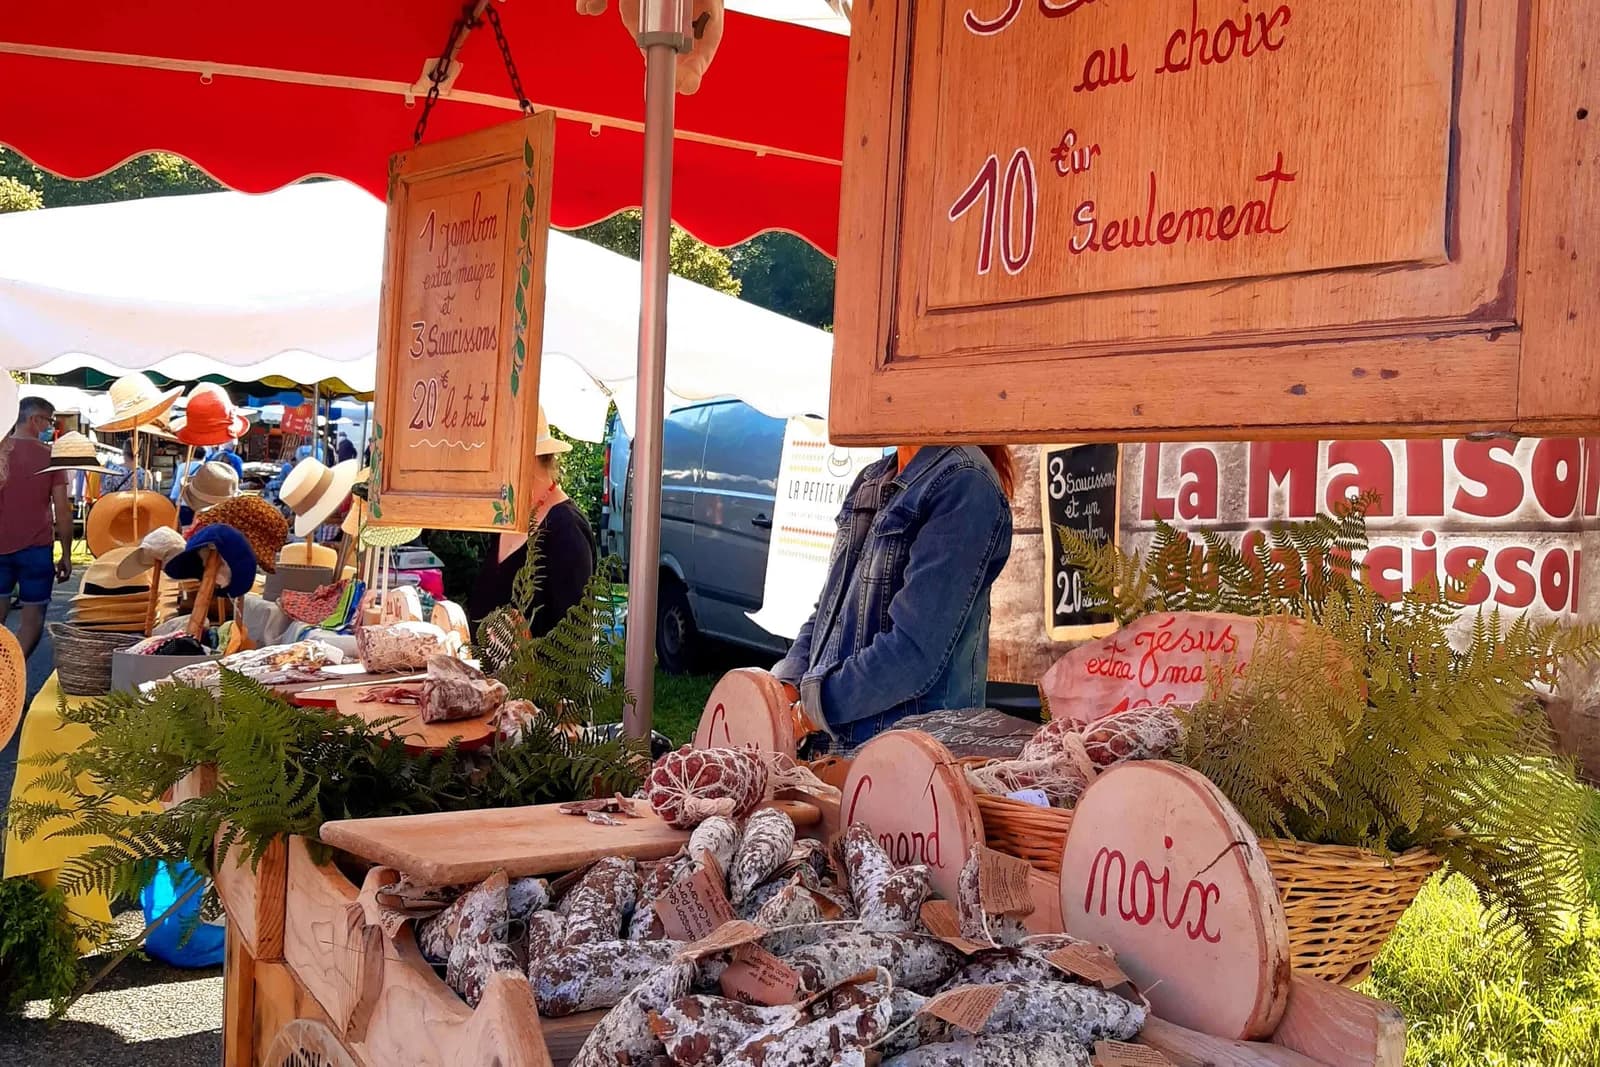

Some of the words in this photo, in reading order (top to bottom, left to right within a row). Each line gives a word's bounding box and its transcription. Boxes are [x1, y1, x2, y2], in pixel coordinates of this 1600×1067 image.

[1073, 43, 1137, 93] au
[1155, 0, 1292, 73] choix
[948, 146, 1038, 275] 10
[1068, 151, 1299, 255] Seulement
[419, 209, 436, 254] 1
[440, 191, 498, 269] jambon
[422, 255, 453, 290] extra
[455, 252, 496, 301] maigre
[440, 290, 456, 317] et
[408, 321, 426, 360] 3
[427, 317, 497, 358] Saucissons
[441, 385, 458, 429] le
[461, 383, 490, 428] tout
[789, 479, 800, 500] LA
[803, 481, 835, 504] PETITE
[1049, 456, 1067, 500] 3
[1140, 440, 1218, 520] La
[1065, 496, 1080, 519] et
[1083, 499, 1100, 518] un
[1056, 571, 1082, 615] 20
[1085, 640, 1136, 681] extra
